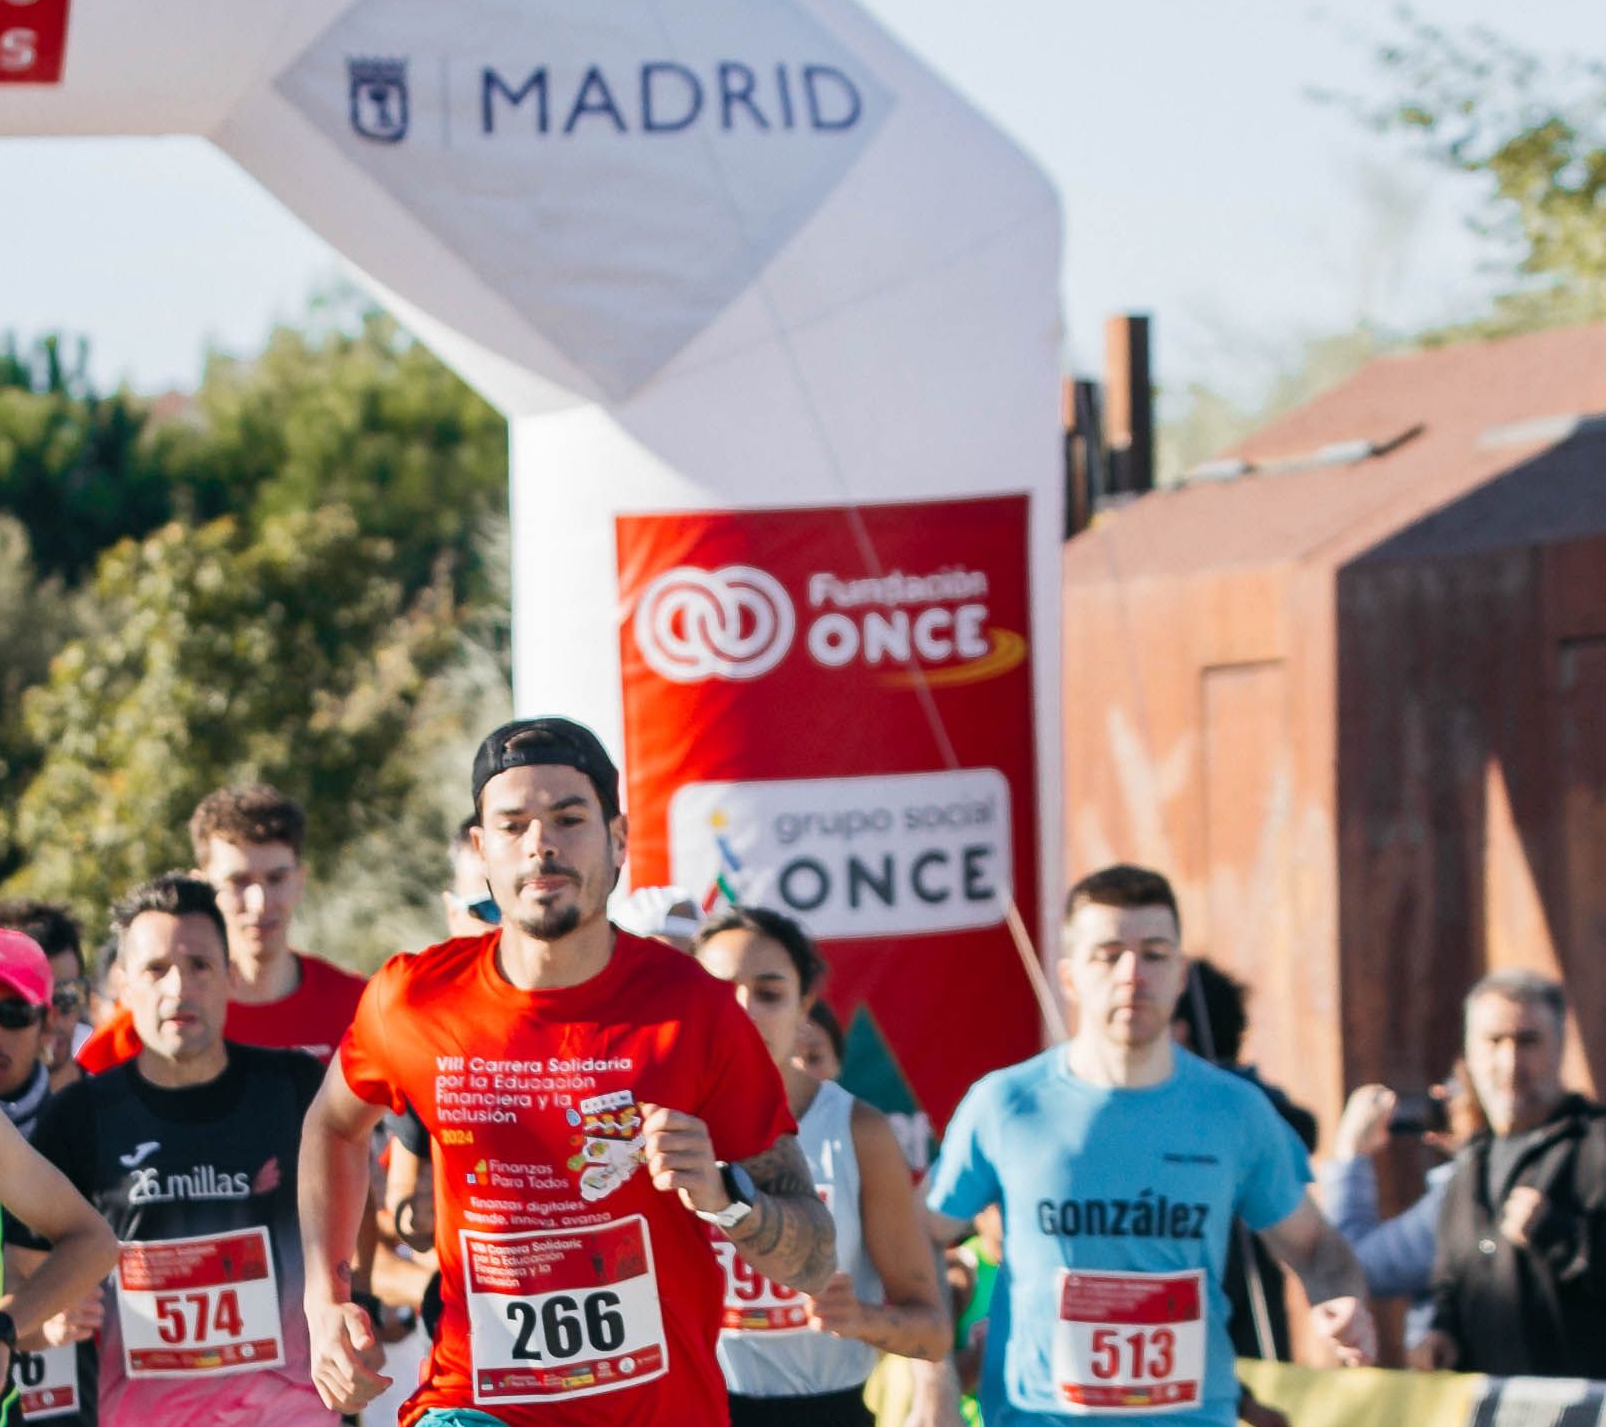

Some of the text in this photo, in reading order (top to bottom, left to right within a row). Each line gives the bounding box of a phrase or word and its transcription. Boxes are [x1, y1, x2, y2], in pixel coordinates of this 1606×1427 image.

[482, 61, 862, 135] MADRID
[808, 566, 988, 608] Fundación
[808, 603, 990, 667] ONCE
[775, 794, 996, 844] grupo social
[778, 843, 998, 912] ONCE
[436, 1055, 633, 1073] VIII Carrera Solidaria
[436, 1074, 596, 1091] por la Educación
[436, 1090, 572, 1110] Financiera y la
[437, 1107, 518, 1123] Inclusión
[441, 1129, 474, 1145] 2024
[167, 1165, 251, 1200] millas
[489, 1159, 553, 1174] Finanzas
[491, 1174, 570, 1190] Para Todos
[561, 1211, 612, 1226] avanza
[155, 1289, 245, 1344] 574
[506, 1290, 626, 1362] 266
[1090, 1328, 1177, 1379] 513
